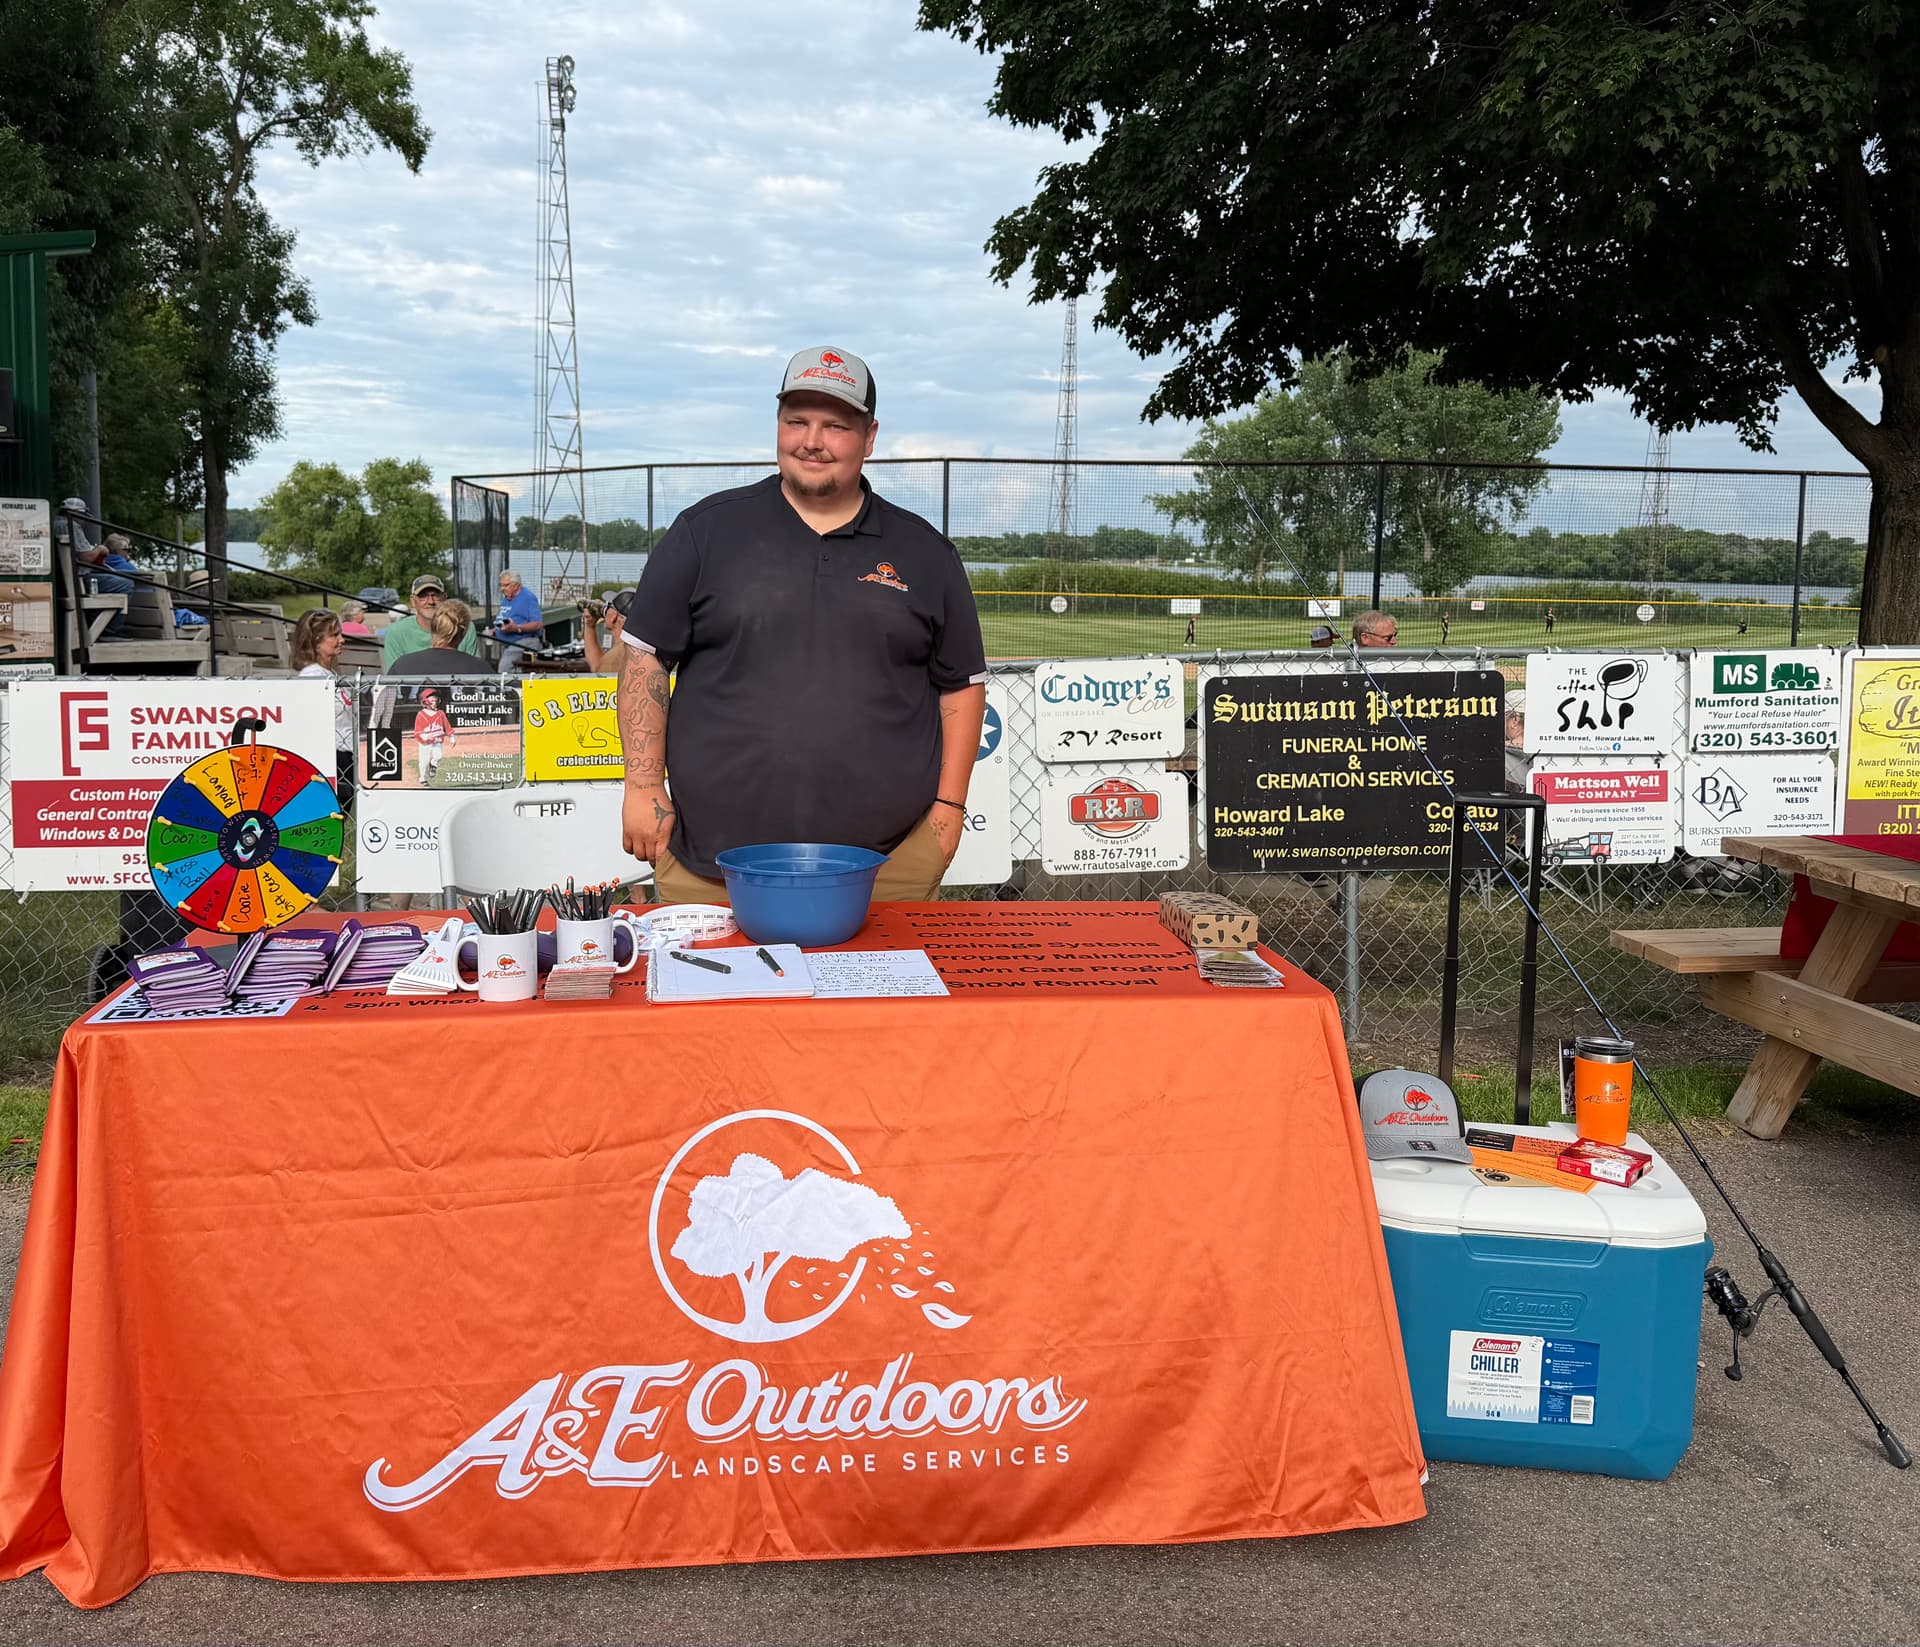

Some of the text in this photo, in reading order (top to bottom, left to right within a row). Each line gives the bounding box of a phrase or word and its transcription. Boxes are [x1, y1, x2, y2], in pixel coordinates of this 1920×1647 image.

[1568, 667, 1588, 676] THE
[1722, 663, 1758, 686] MS
[1040, 671, 1171, 708] Codger's
[451, 691, 507, 702] Good Luck
[1694, 695, 1839, 709] Mumford Sanitation
[446, 704, 513, 716] Howard Lake
[1212, 690, 1499, 726] Swanson Peterson
[1734, 710, 1759, 719] Local
[1760, 709, 1792, 718] Refuse
[130, 706, 282, 726] SWANSON
[456, 716, 502, 728] Baseball!
[1703, 720, 1831, 731] www.mumfordsanitation.com
[131, 731, 232, 751] FAMILY
[1057, 728, 1163, 748] RV Resort
[1692, 730, 1838, 750] (320) 543-3601
[1281, 735, 1428, 754] FUNERAL HOME
[458, 760, 514, 770] Owner/Broker
[1347, 754, 1362, 770] &
[1857, 757, 1887, 767] Award
[444, 771, 514, 784] 320.543.3443
[1256, 769, 1456, 790] CREMATION SERVICES
[1802, 775, 1822, 783] YOUR
[1885, 769, 1904, 778] Fine
[1554, 774, 1660, 790] Mattson Well
[1864, 779, 1918, 790] NEW! Ready
[70, 788, 125, 802] Custom
[1577, 789, 1638, 799] COMPANY
[1775, 785, 1819, 793] INSURANCE
[1875, 790, 1891, 798] with
[1892, 790, 1908, 799] pork
[1784, 796, 1810, 804] NEEDS
[1084, 796, 1146, 820] R&R
[1214, 804, 1345, 824] Howard Lake
[1425, 801, 1498, 820] Coato
[36, 808, 99, 823] General
[1572, 815, 1595, 823] drilling
[1608, 814, 1636, 822] backhoe
[1637, 813, 1663, 821] services
[1772, 813, 1824, 822] 320-543-3171
[1214, 825, 1285, 838] 320-543-3401
[1427, 822, 1499, 834] 320-6-2534
[1688, 826, 1752, 836] BURKSTRAND
[1877, 823, 1913, 835] (320)
[39, 827, 120, 842] Windows &
[1073, 847, 1158, 861] 888-767-7911
[1252, 844, 1453, 859] www.swansonpeterson.com
[1614, 848, 1667, 857] 320-543-2441
[1053, 858, 1179, 873] www.rrautosalvage.com
[905, 911, 982, 919] Patios
[998, 910, 1114, 918] Retaining
[911, 920, 1073, 929] Landscaping
[923, 941, 1161, 950] Drainage Systems
[931, 953, 1056, 963] Property
[938, 966, 1013, 975] Lawn
[1019, 966, 1086, 974] Care
[946, 978, 1158, 989] Snow Removal
[343, 1001, 405, 1011] Spin
[1494, 1295, 1557, 1315] Coleman
[1475, 1339, 1511, 1352] Coleman
[1470, 1354, 1519, 1374] CHILLER
[362, 1352, 1089, 1514] A&E Outdoors
[671, 1445, 1071, 1480] LANDSCAPE SERVICES
